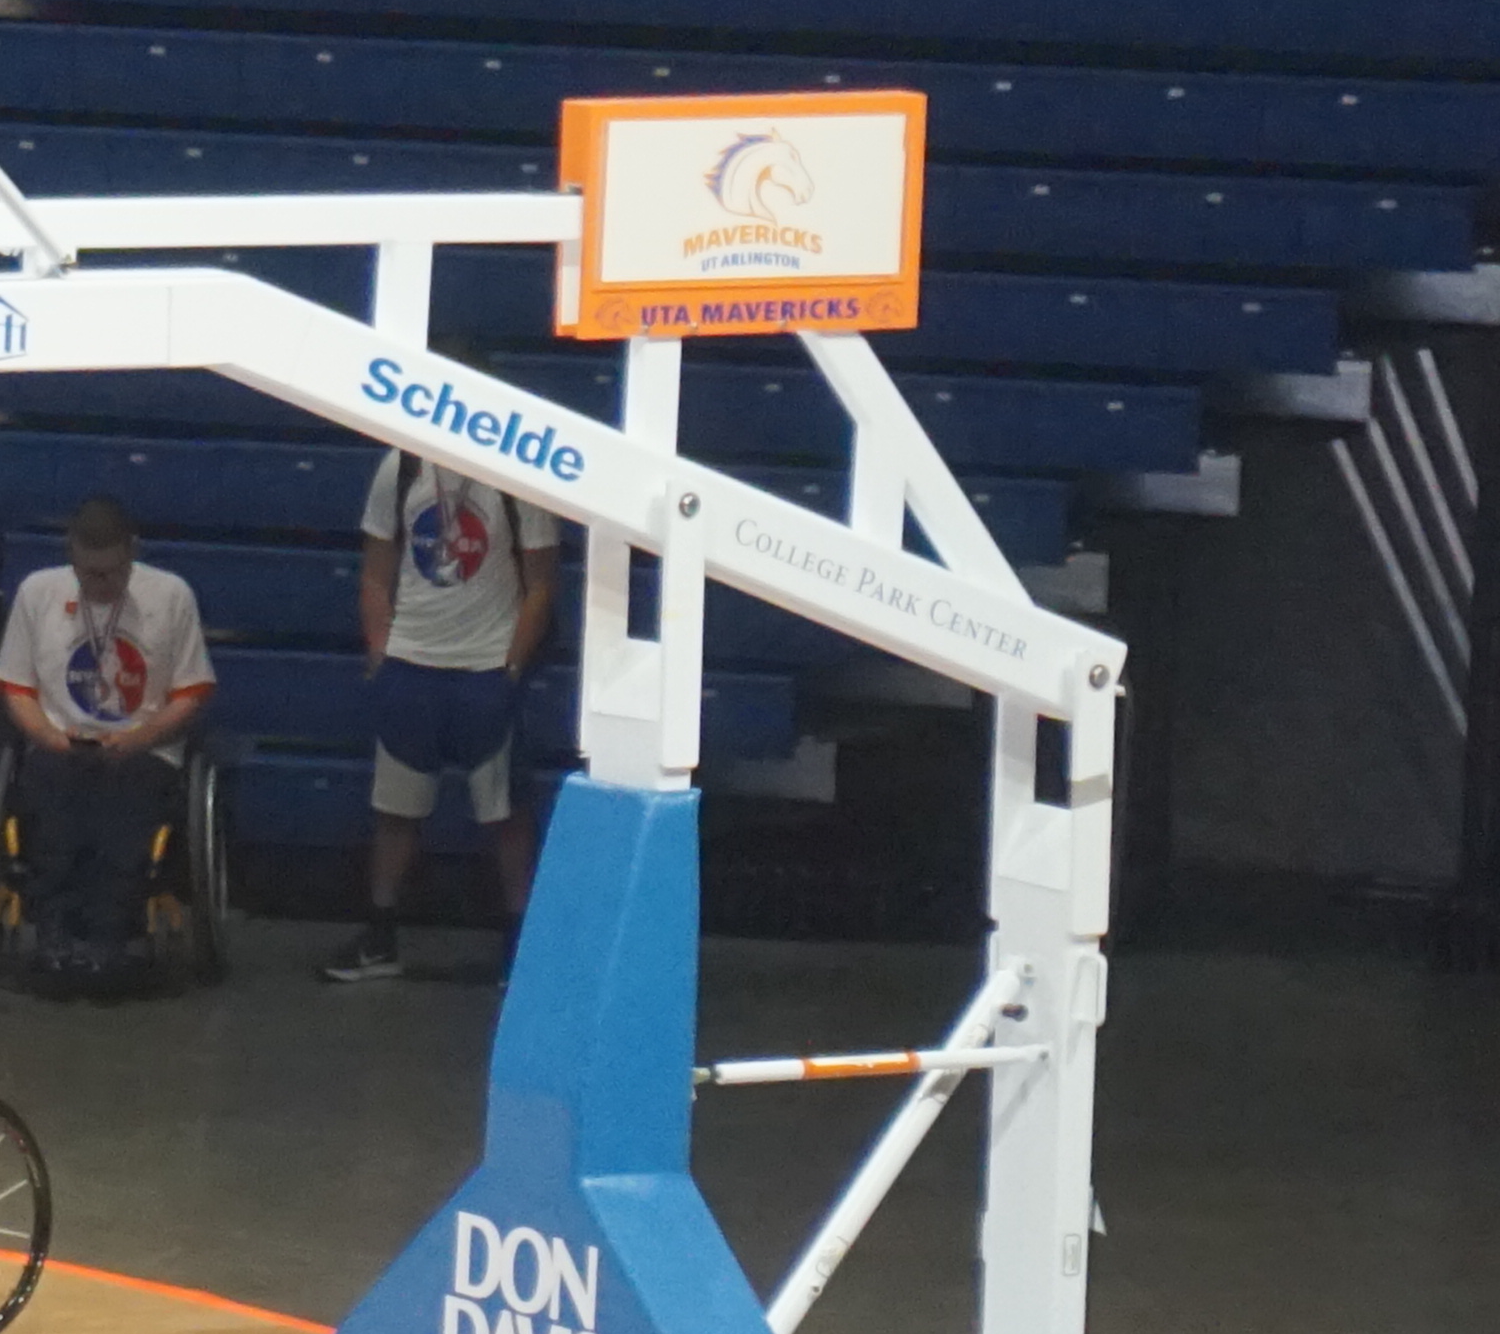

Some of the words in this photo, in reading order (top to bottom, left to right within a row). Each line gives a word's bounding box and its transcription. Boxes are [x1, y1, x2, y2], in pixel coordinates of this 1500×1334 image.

[683, 224, 824, 259] MAVERICKS
[701, 256, 718, 273] UT
[721, 251, 801, 270] ARLINGTON
[641, 305, 691, 327] UTA
[702, 298, 861, 324] MAVERICKS
[360, 357, 585, 484] Schelde
[734, 517, 849, 585] COLLEGE
[855, 566, 923, 618] PARK
[928, 598, 1029, 662] CENTER
[455, 1210, 598, 1331] DON
